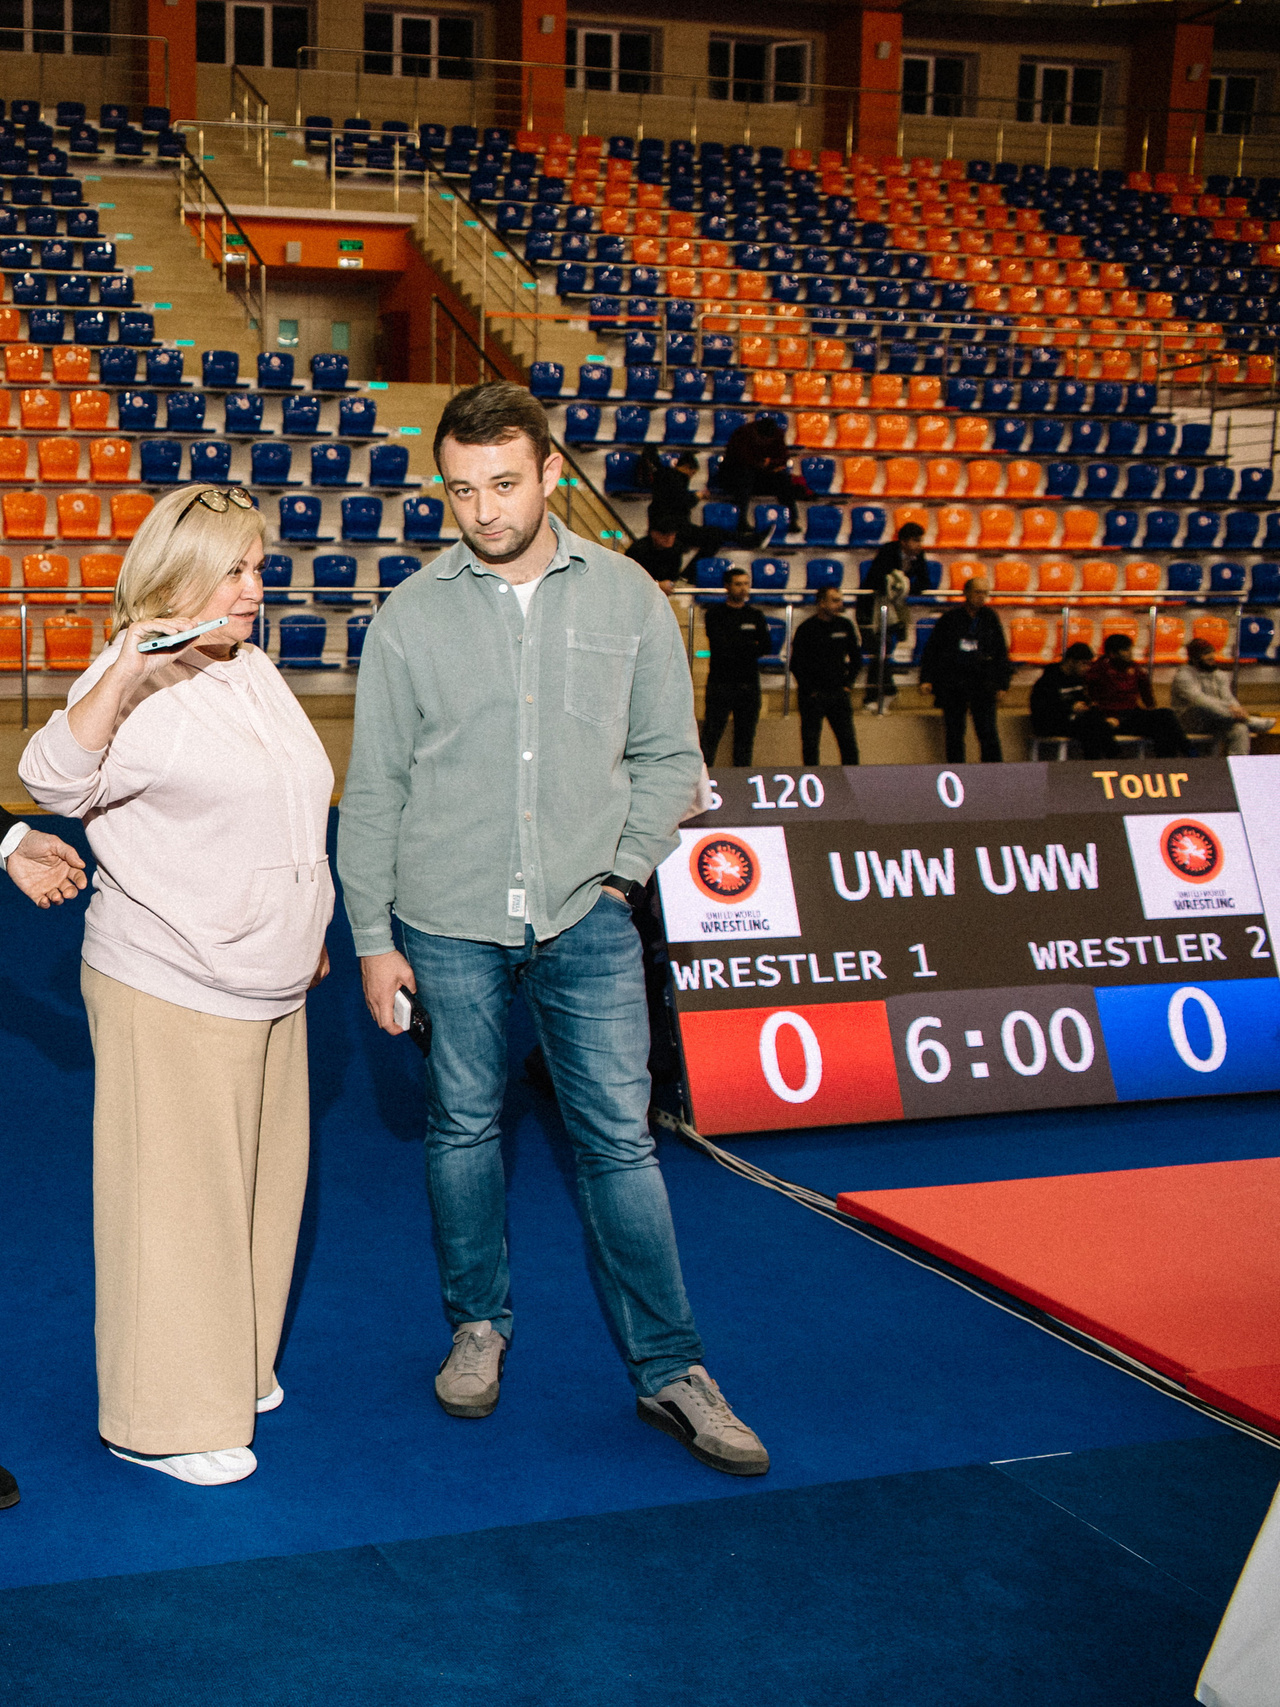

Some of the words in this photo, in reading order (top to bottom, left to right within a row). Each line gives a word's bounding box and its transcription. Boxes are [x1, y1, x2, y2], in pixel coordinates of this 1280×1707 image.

[747, 773, 825, 809] 120
[936, 770, 965, 808] 0
[1092, 770, 1189, 799] Tour
[828, 847, 956, 901] UWW
[975, 842, 1099, 895] UWW
[701, 919, 770, 932] WRESTLING
[1174, 898, 1235, 910] WRESTLING
[670, 950, 888, 991] WRESTLER
[908, 943, 937, 978] 1
[1027, 933, 1228, 971] WRESTLER
[1245, 926, 1271, 959] 2
[905, 1006, 1096, 1084] 6:00
[1167, 986, 1228, 1073] 0
[759, 1010, 823, 1104] 0
